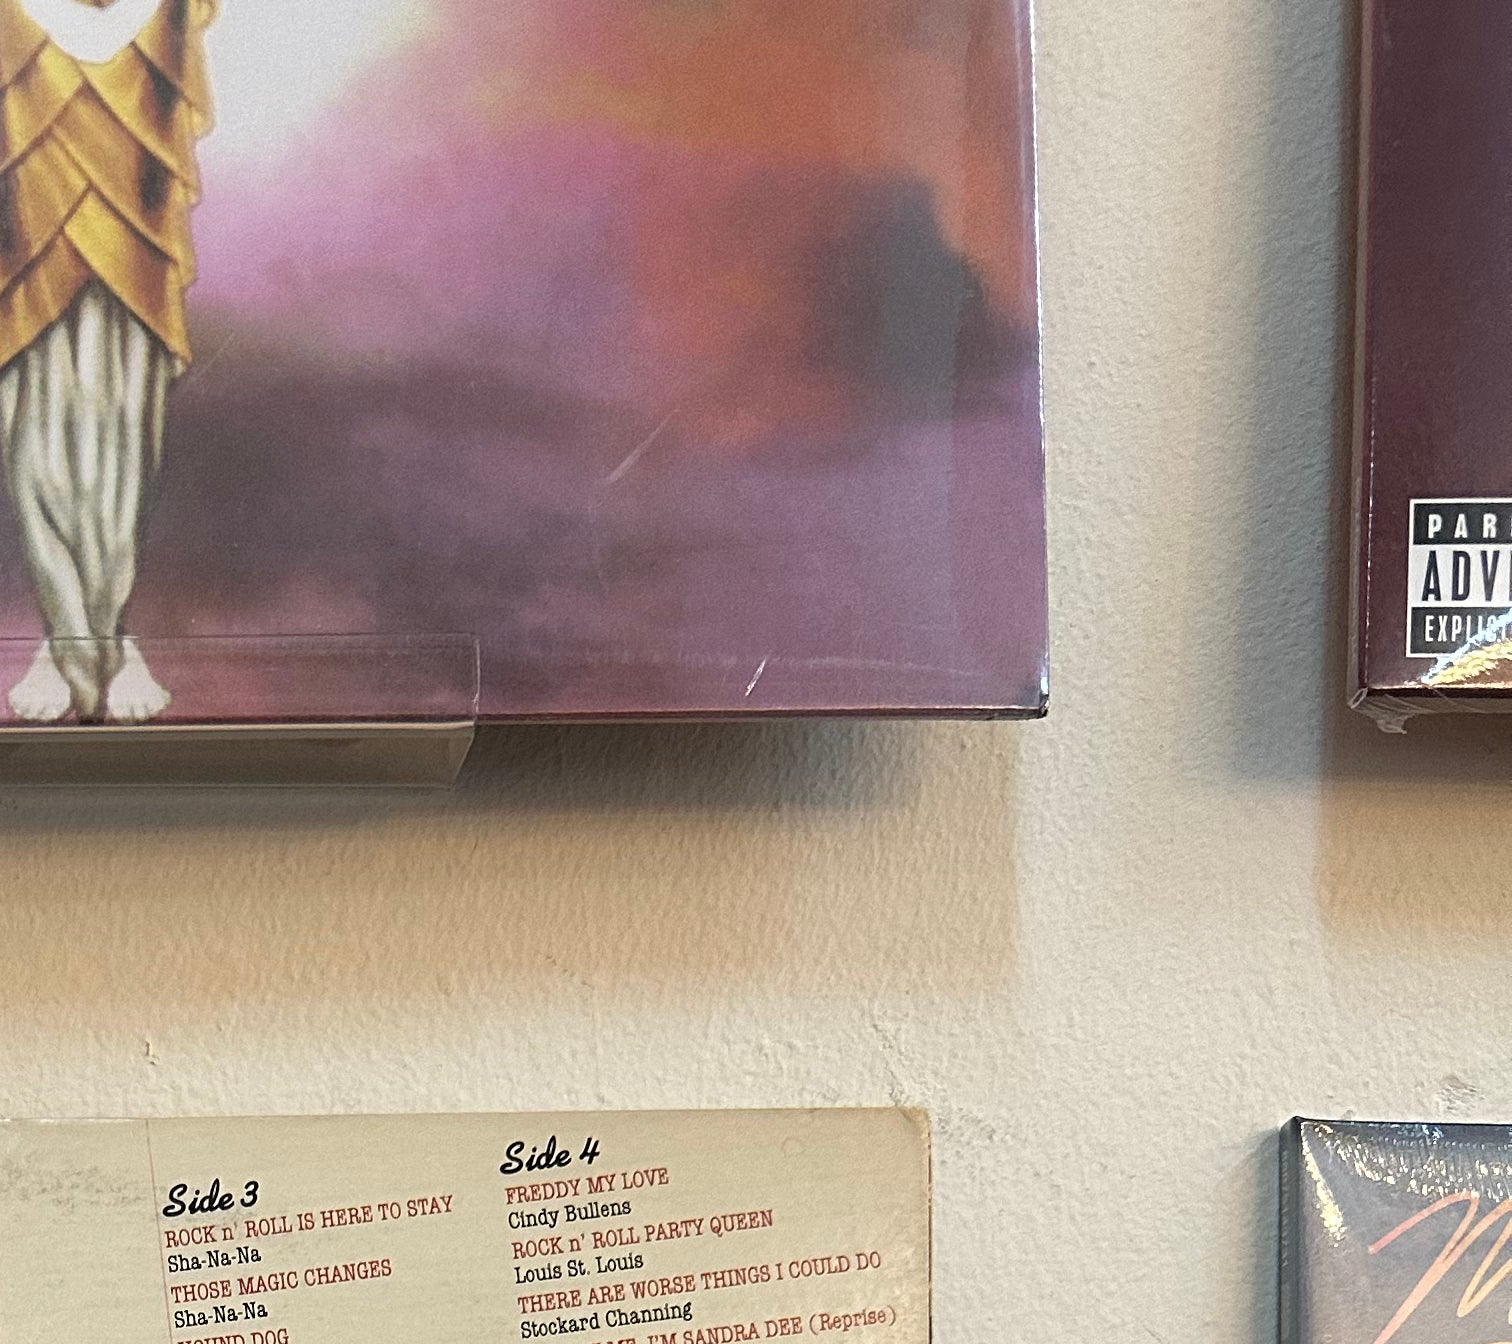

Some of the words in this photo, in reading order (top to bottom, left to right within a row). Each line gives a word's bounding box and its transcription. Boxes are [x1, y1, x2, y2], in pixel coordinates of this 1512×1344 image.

[1427, 513, 1512, 539] PAR
[1421, 550, 1512, 601] ADV
[500, 1135, 572, 1174] Side
[579, 1136, 600, 1165] 4
[162, 1178, 234, 1217] Side
[240, 1180, 259, 1207] 3
[505, 1178, 580, 1205] FREDDY
[586, 1174, 616, 1194] MY
[621, 1168, 668, 1190] LOVE
[164, 1225, 217, 1248] ROCK
[244, 1216, 292, 1238] ROLL
[297, 1213, 314, 1231] IS
[320, 1206, 373, 1228] HERE
[378, 1202, 401, 1220] TO
[407, 1194, 452, 1217] STAY
[508, 1208, 559, 1229] Cindy
[564, 1201, 632, 1222] Bullens
[511, 1236, 564, 1259] ROCK
[592, 1226, 640, 1249] ROLL
[644, 1218, 704, 1242] PARTY
[710, 1209, 772, 1237] QUEEN
[168, 1246, 261, 1272] Sha-Na-Na
[171, 1280, 232, 1304] THOSE
[237, 1271, 298, 1295] MAGIC
[304, 1259, 392, 1286] CHANGES
[174, 1301, 268, 1328] Sha-Na-Na
